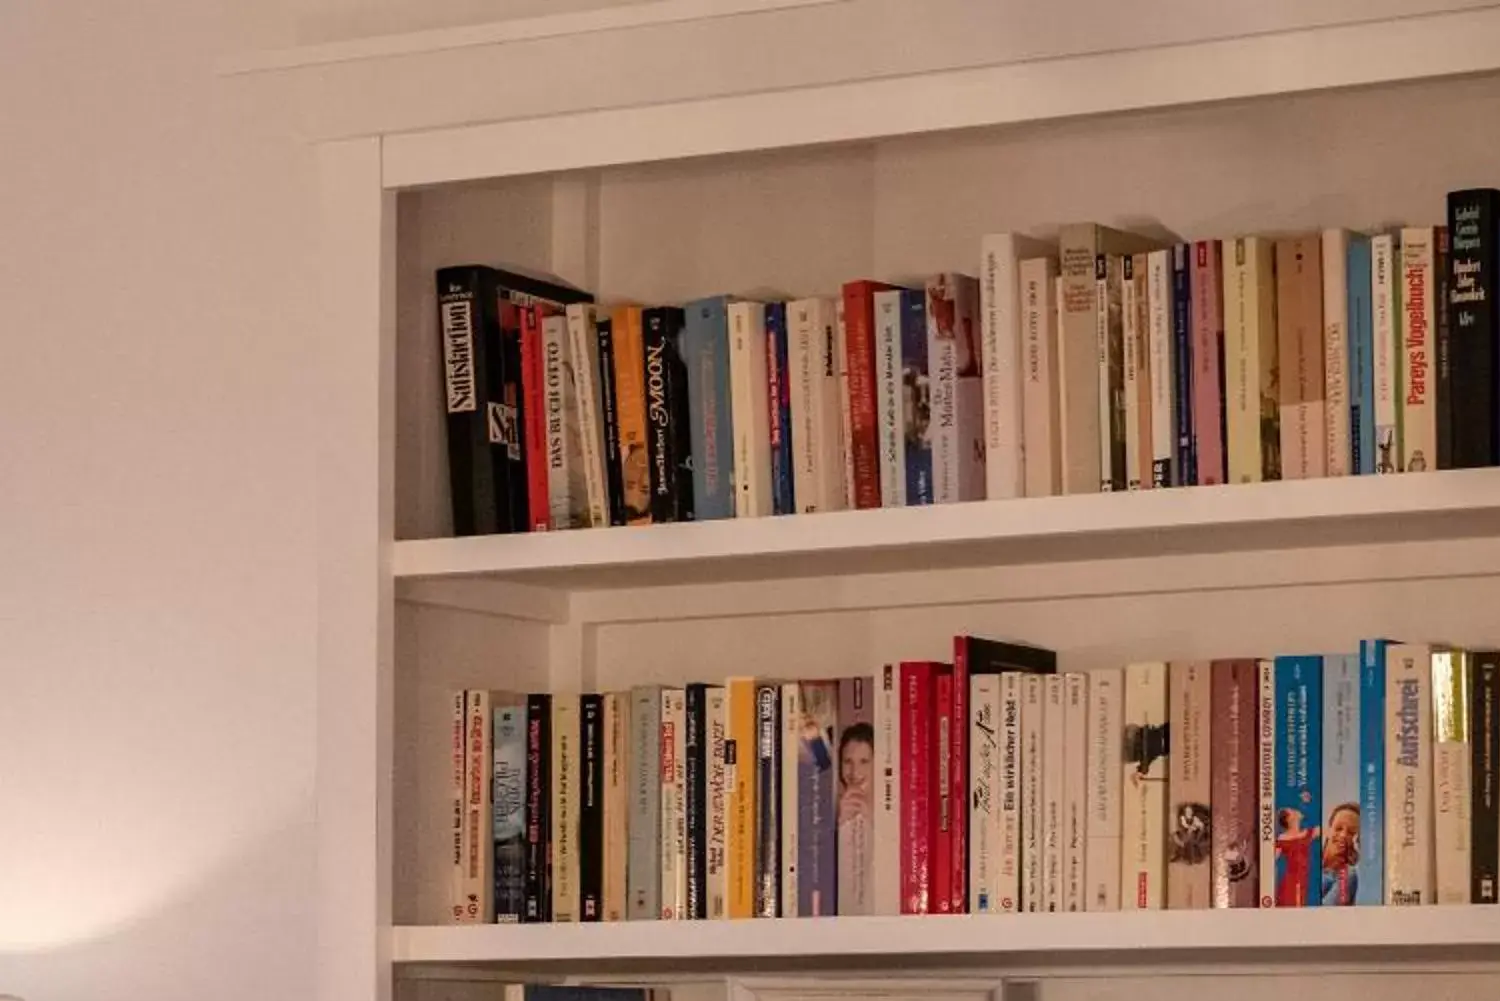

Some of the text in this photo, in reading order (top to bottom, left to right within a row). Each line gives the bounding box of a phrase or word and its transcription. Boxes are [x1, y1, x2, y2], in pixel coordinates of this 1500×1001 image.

[447, 303, 472, 409] Satisfaction
[1404, 267, 1428, 406] Pareys Vogelbuch
[546, 341, 563, 469] DAS BUCH OTTO
[647, 336, 669, 426] MOON
[1004, 700, 1016, 728] Held
[1396, 679, 1419, 767] Aufschrei
[1004, 730, 1016, 789] wirklicher
[1004, 790, 1015, 812] Ein
[1262, 804, 1272, 842] FOGLE
